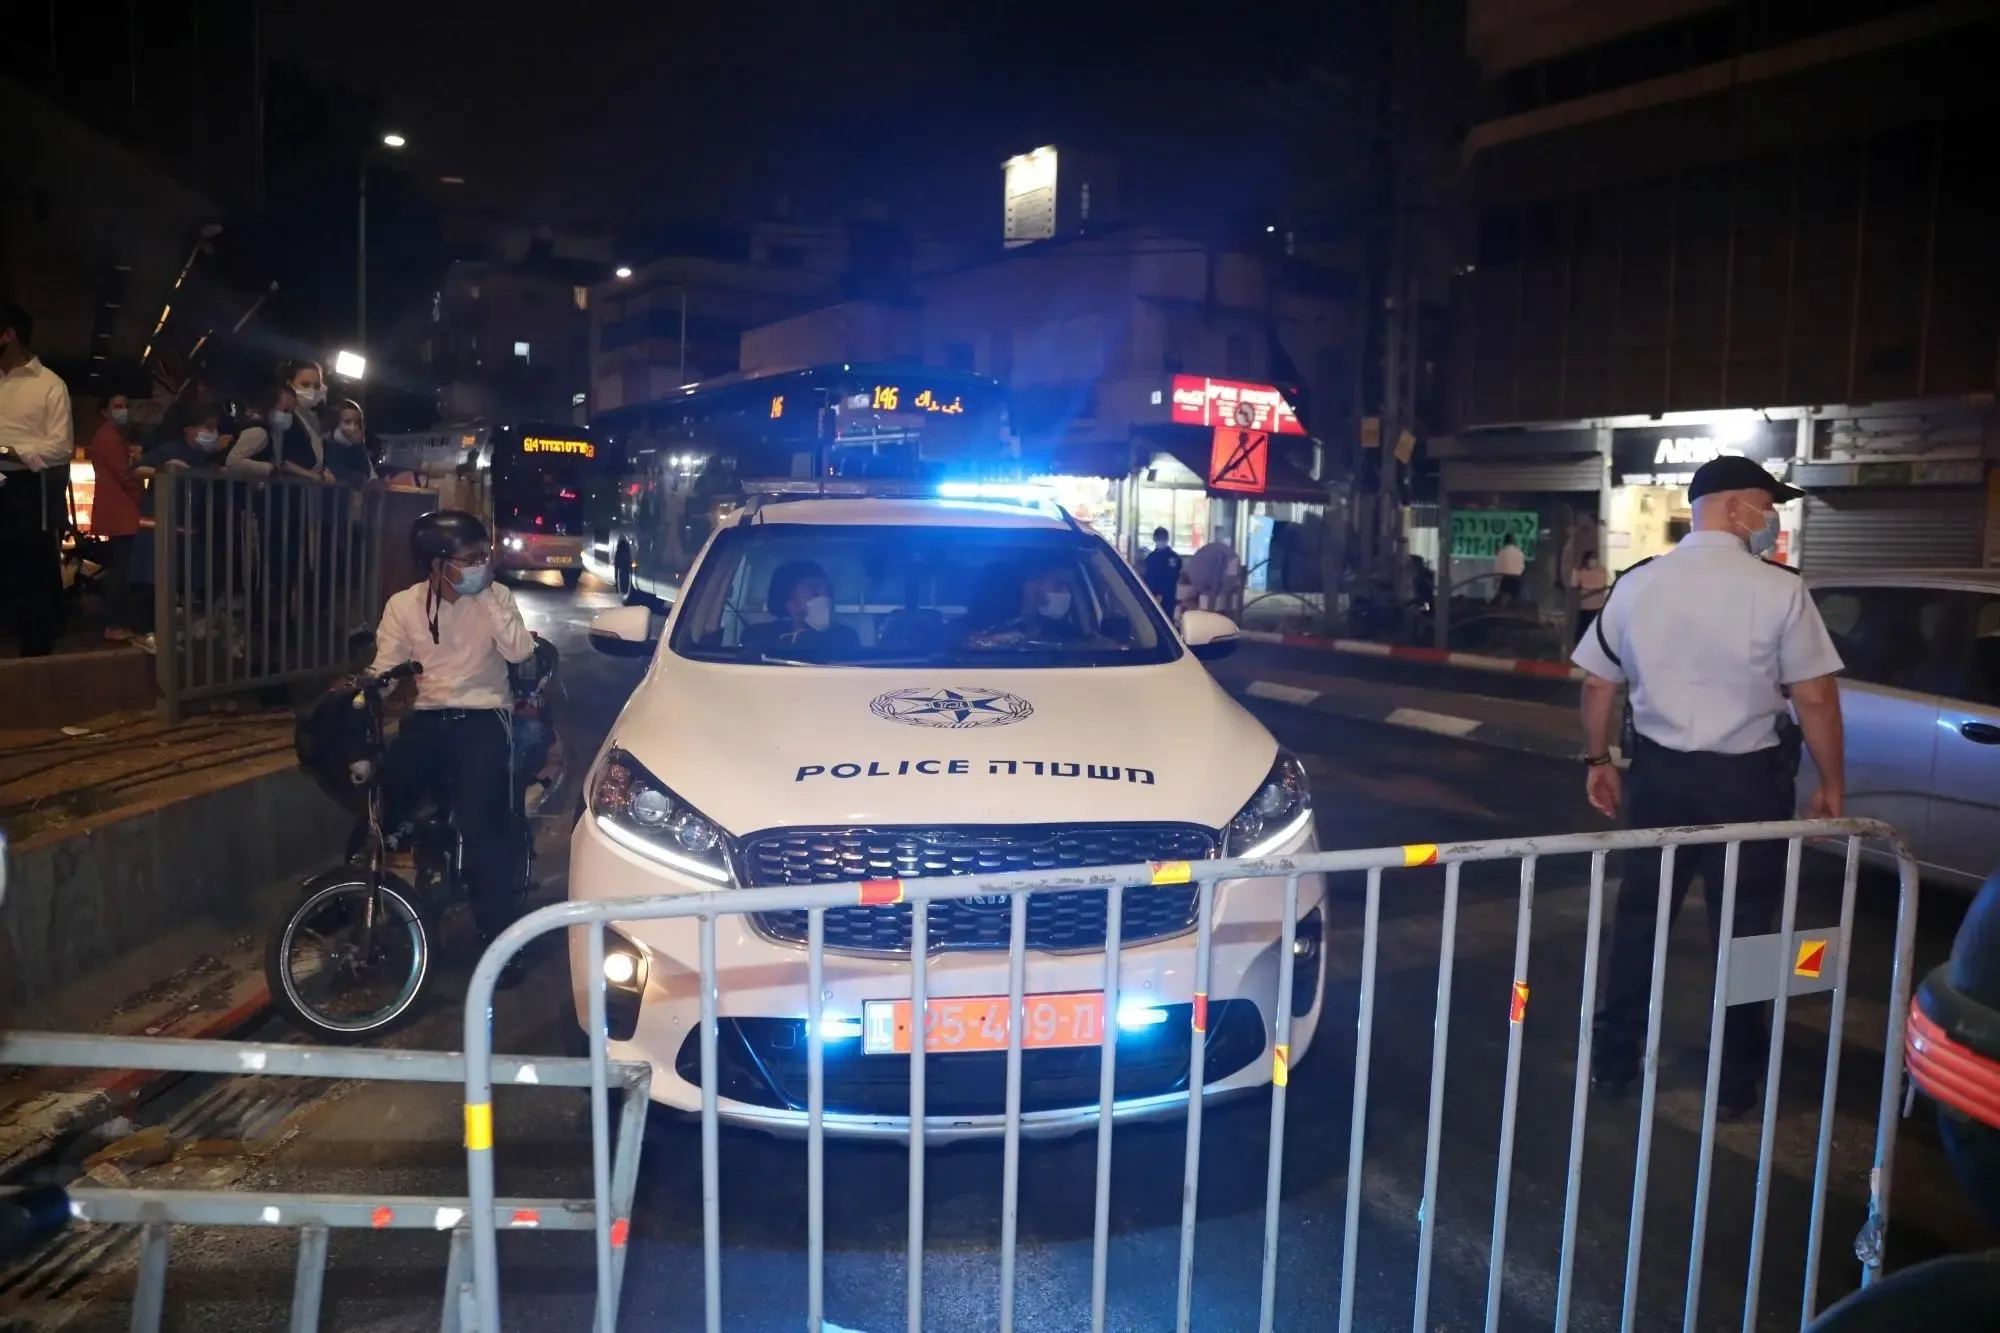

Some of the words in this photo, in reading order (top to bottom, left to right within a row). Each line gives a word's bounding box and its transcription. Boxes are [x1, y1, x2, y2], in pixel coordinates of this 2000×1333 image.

[873, 386, 899, 410] 146
[795, 759, 970, 782] POLICE
[988, 759, 1155, 785] משטרה
